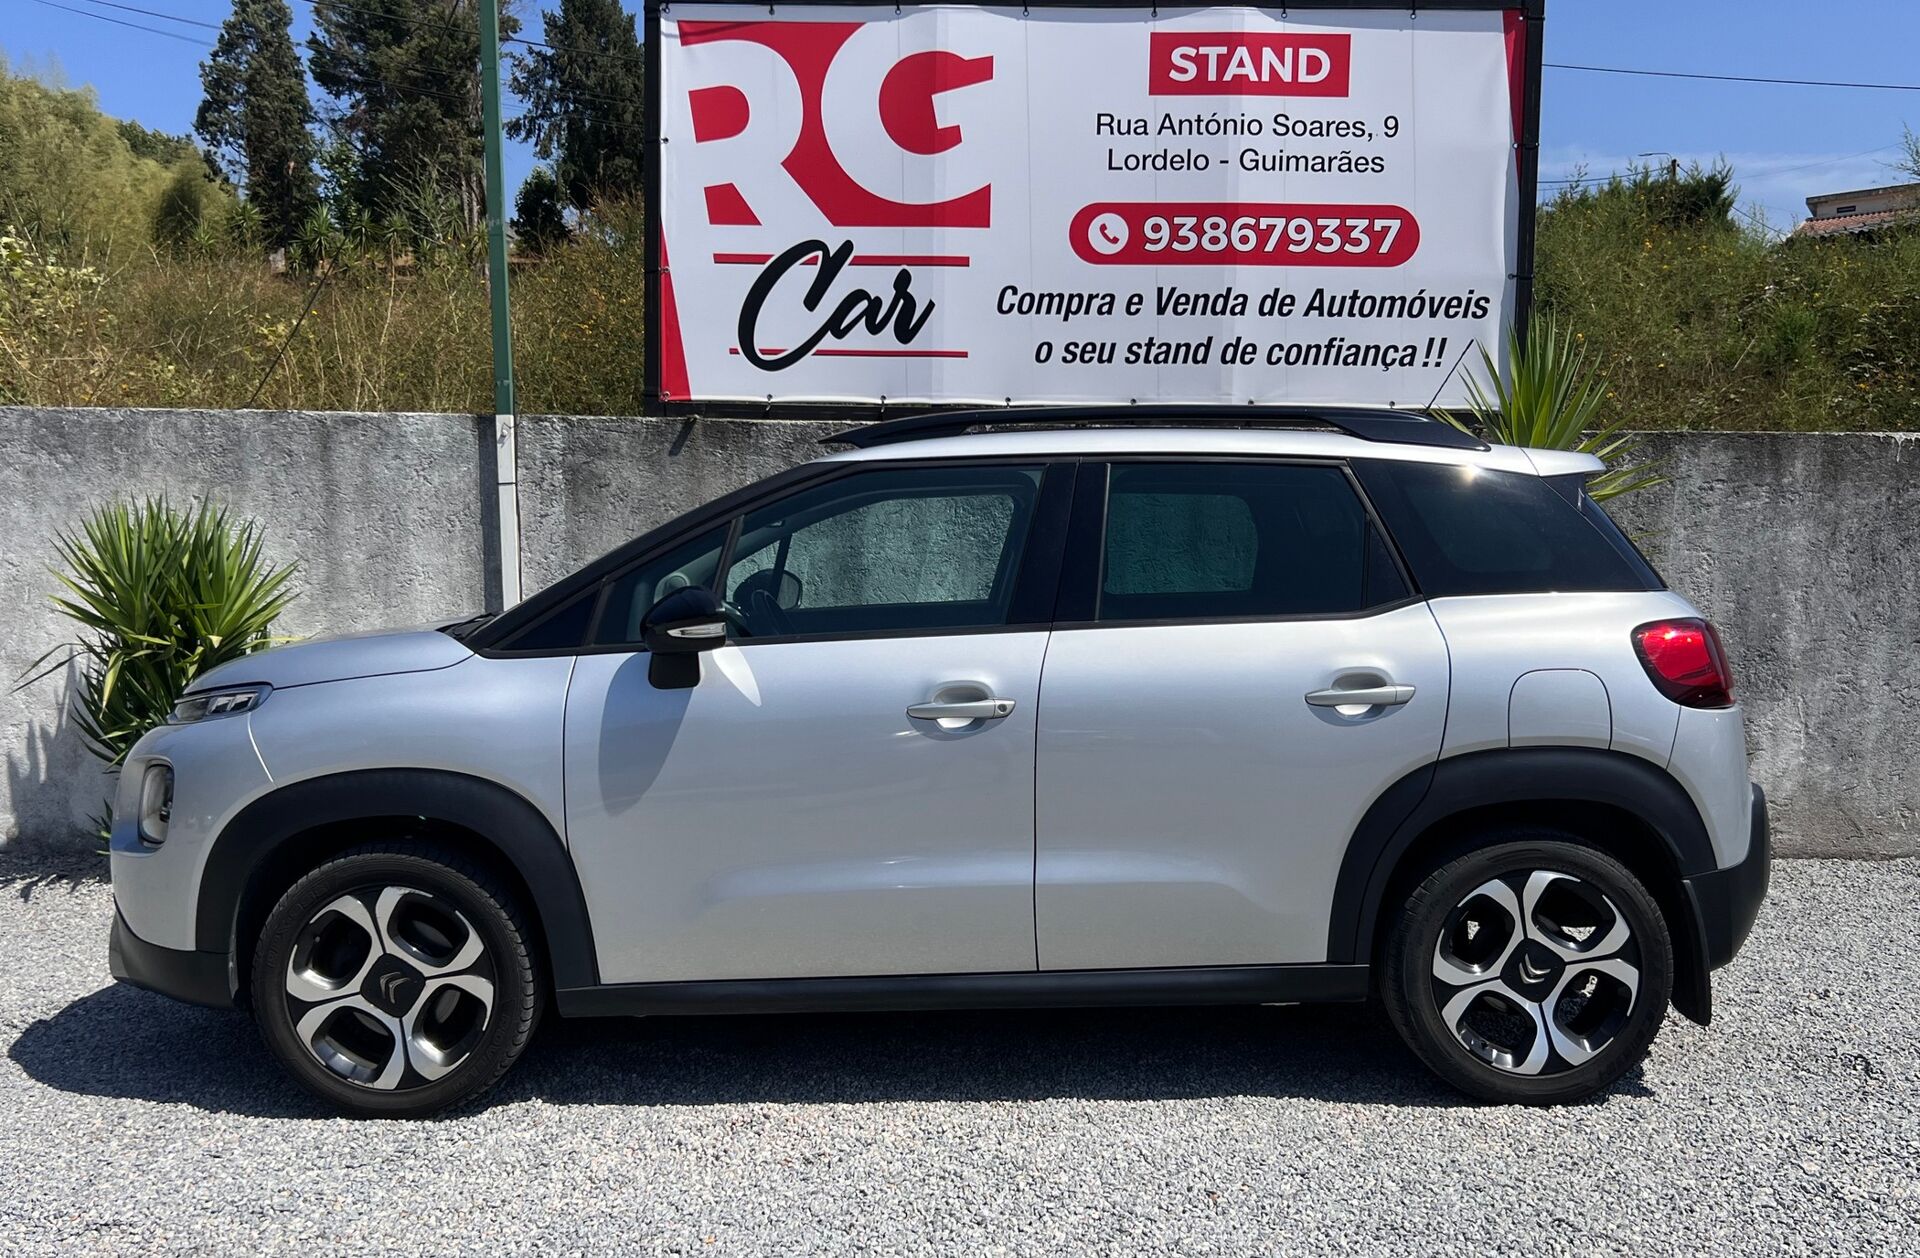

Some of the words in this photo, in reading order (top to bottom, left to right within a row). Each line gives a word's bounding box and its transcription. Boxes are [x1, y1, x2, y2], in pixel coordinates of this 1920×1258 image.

[1168, 46, 1331, 83] STAND
[678, 21, 994, 228] RG
[1096, 112, 1149, 136] Rua
[1156, 112, 1263, 136] António
[1272, 113, 1373, 143] Soares,
[1383, 115, 1399, 138] 9
[1108, 148, 1210, 171] Lordelo
[1239, 148, 1385, 174] Guimarães
[1142, 215, 1402, 254] 938679337
[738, 239, 935, 371] Car
[996, 285, 1116, 322] Compra
[1125, 292, 1144, 317] e
[1156, 286, 1248, 317] Venda
[1258, 287, 1296, 318] de
[1302, 287, 1491, 320] Automóveis
[1034, 341, 1054, 364] o
[1061, 341, 1117, 365] seu
[1124, 335, 1214, 365] stand
[1220, 336, 1258, 366] de
